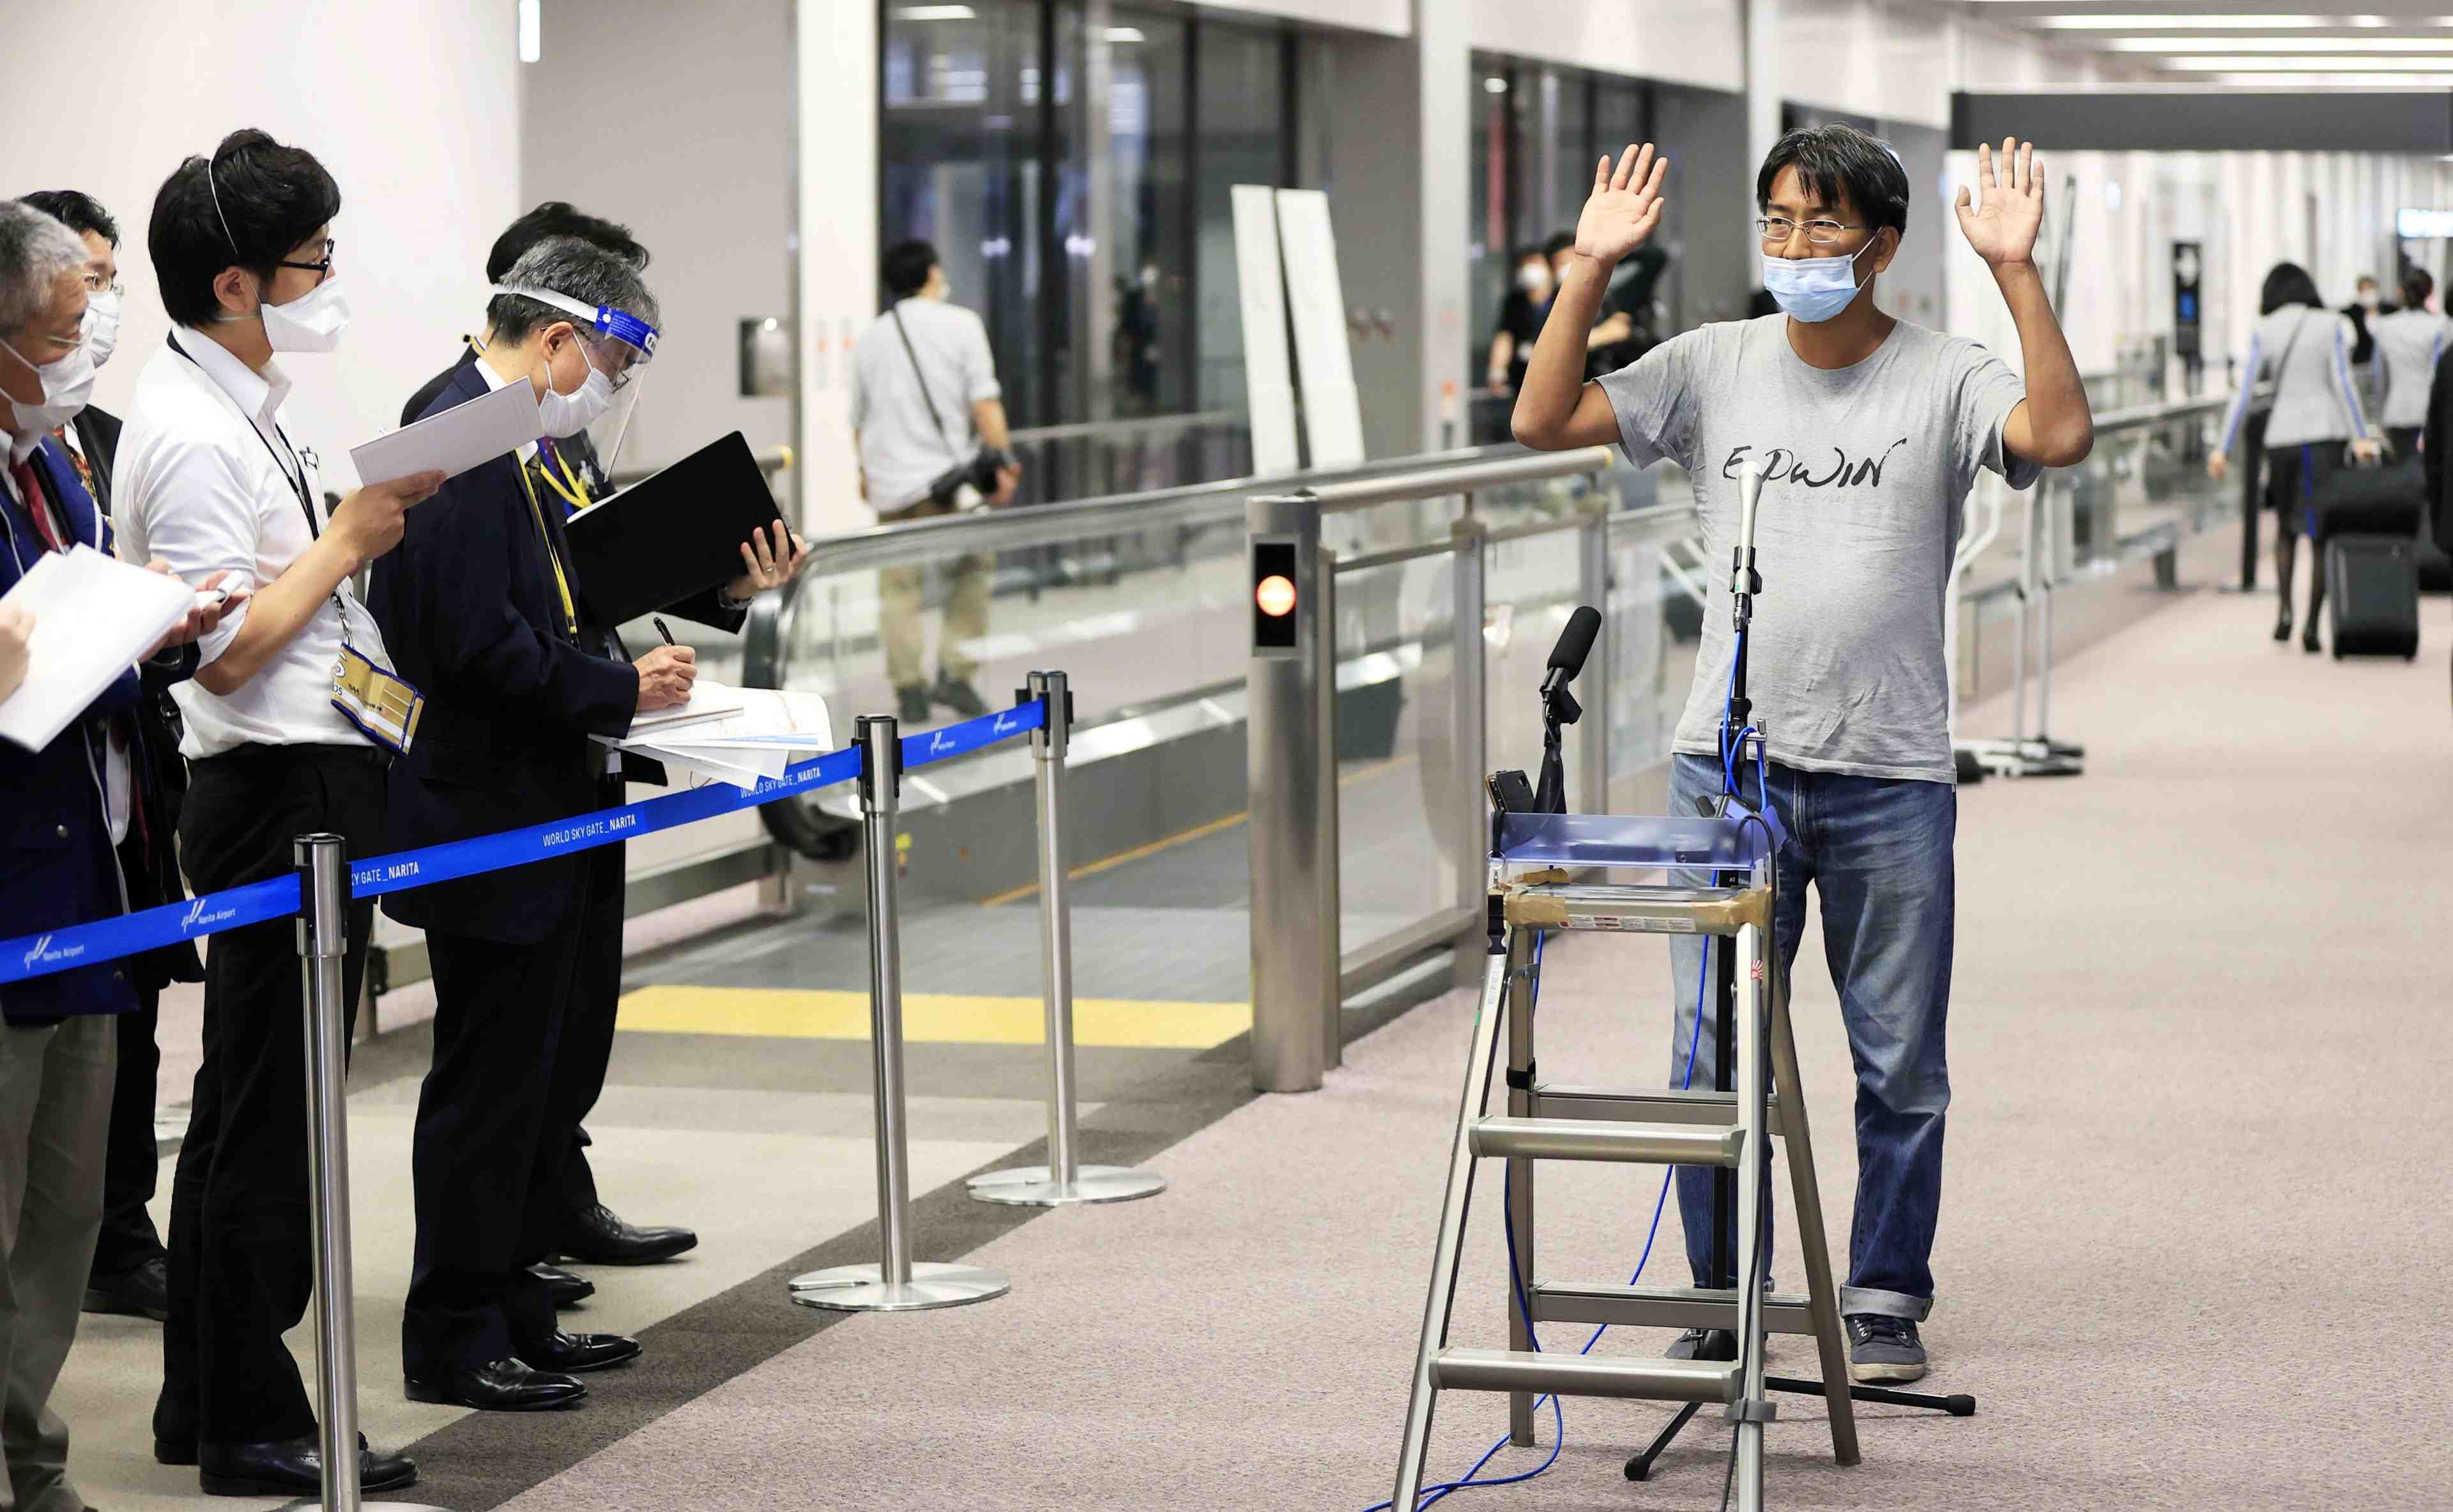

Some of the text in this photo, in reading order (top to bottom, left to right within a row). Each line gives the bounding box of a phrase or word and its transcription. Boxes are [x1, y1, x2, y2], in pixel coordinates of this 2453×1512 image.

[1723, 438, 1907, 488] EDWIN
[542, 830, 570, 847] WORLD
[571, 826, 585, 841] SKY
